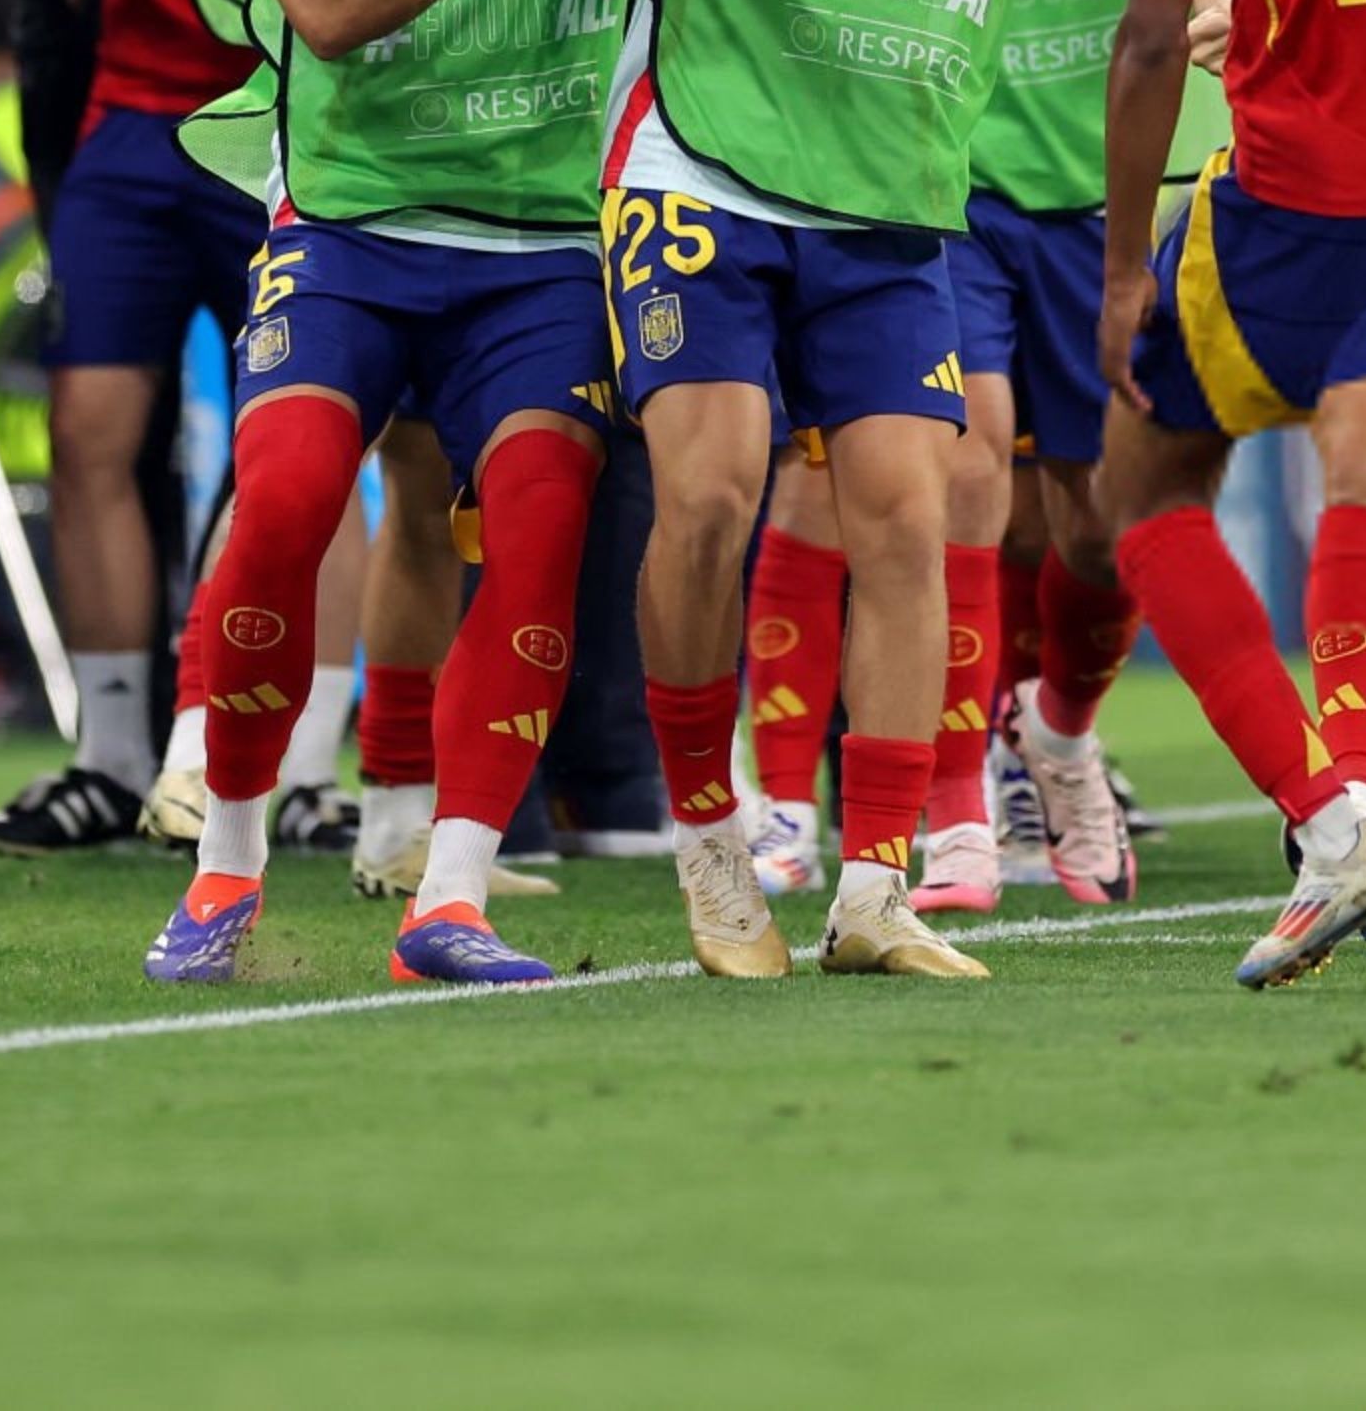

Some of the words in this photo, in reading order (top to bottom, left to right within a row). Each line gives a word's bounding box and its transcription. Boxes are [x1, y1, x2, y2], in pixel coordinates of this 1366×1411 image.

[837, 26, 970, 89] RESPECT
[464, 72, 599, 122] RESPECT
[620, 192, 716, 292] 25
